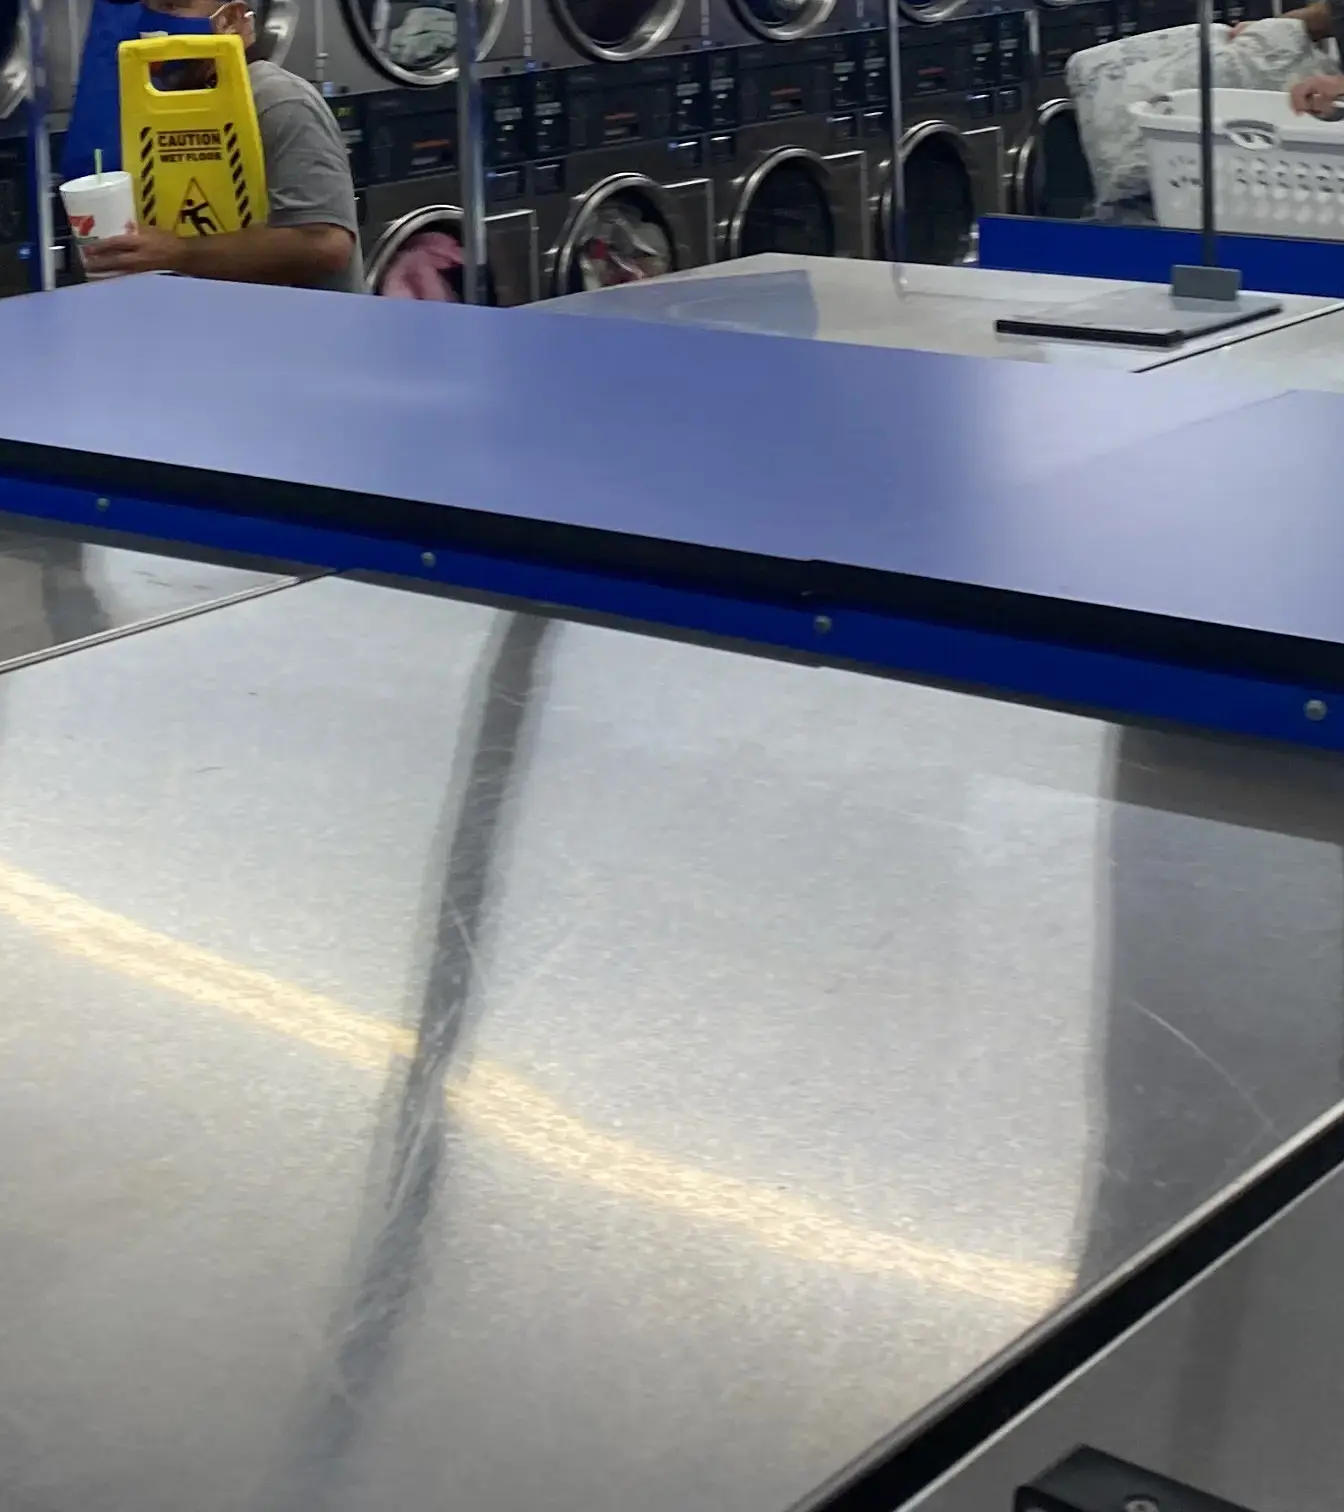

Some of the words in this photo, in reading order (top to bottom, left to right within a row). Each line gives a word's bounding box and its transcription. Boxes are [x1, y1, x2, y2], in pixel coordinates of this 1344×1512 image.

[158, 133, 221, 147] CAUTION
[160, 153, 184, 163] WET
[185, 152, 223, 161] FLOOR
